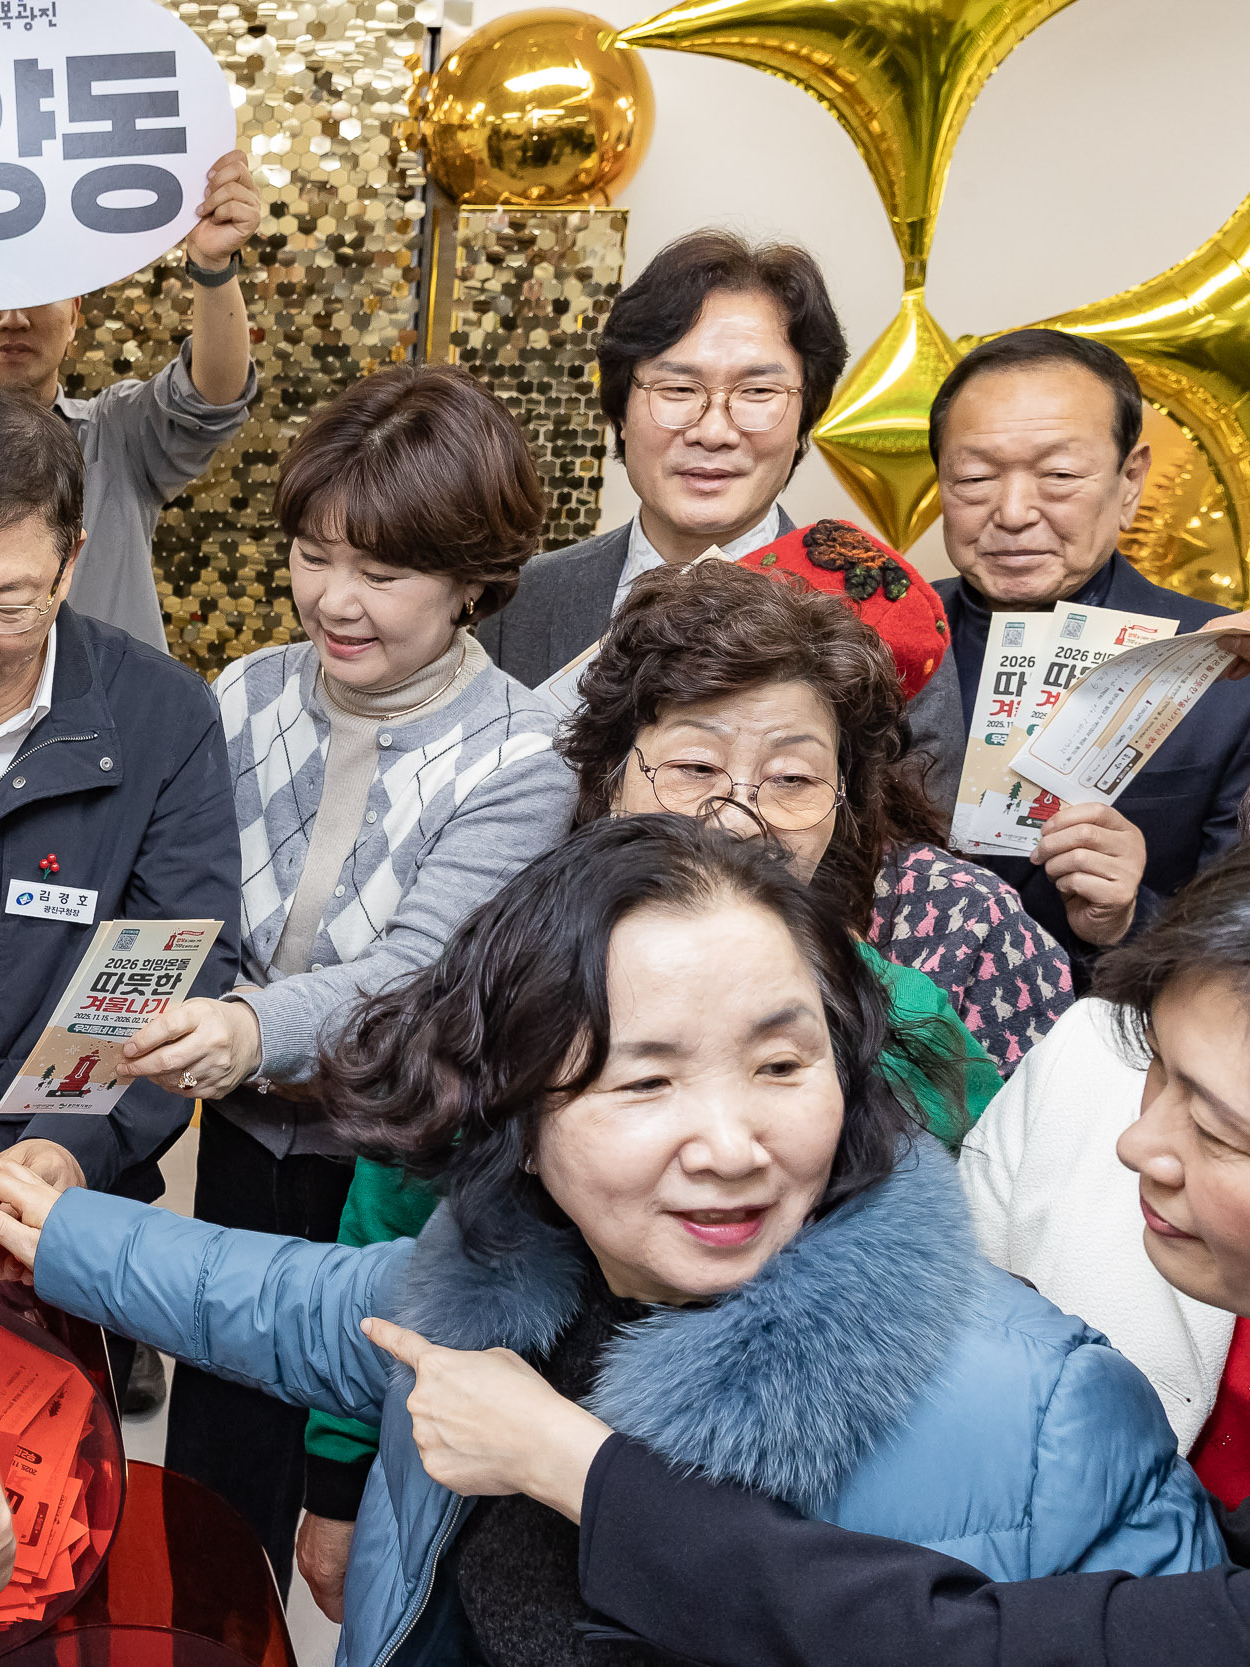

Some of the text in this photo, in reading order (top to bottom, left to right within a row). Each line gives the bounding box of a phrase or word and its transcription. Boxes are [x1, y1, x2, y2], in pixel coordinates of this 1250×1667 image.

[1055, 646, 1090, 662] 2026
[1000, 655, 1036, 668] 2026
[43, 905, 80, 917] 광진구청장
[105, 958, 191, 971] 2026 희망온돌
[90, 972, 182, 996] 따뜻한
[80, 995, 170, 1014] 겨울나기
